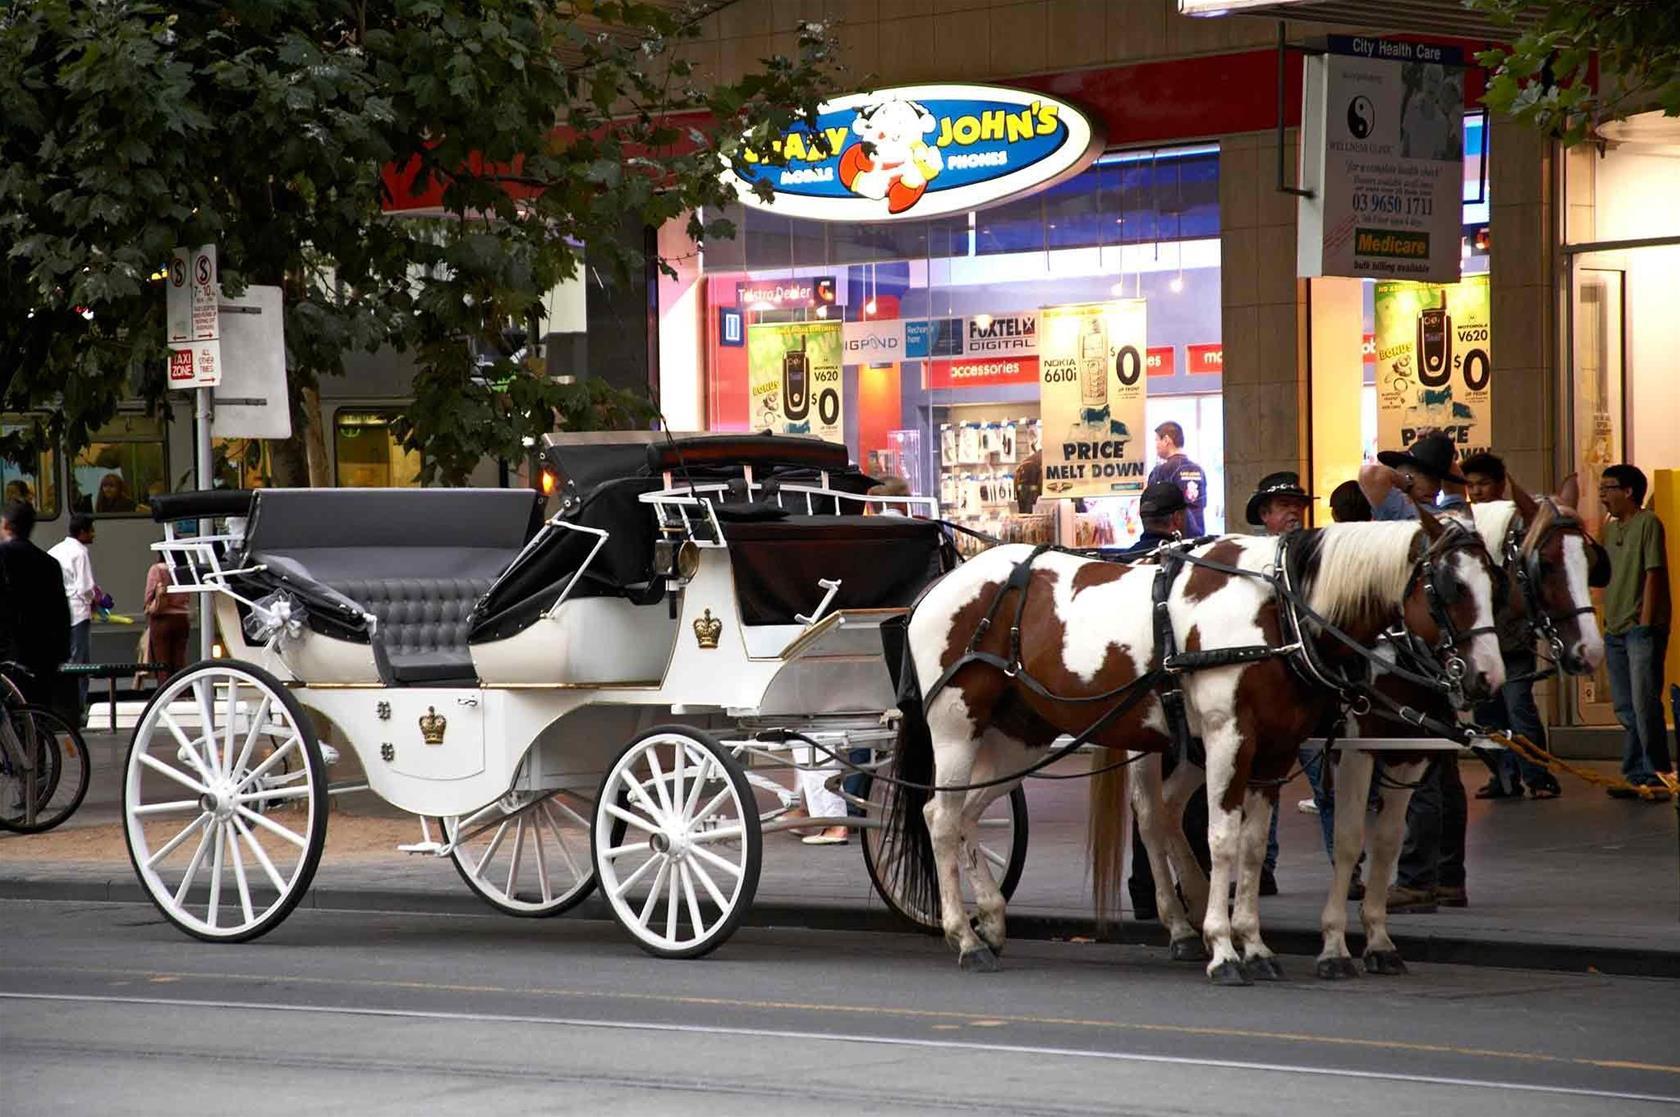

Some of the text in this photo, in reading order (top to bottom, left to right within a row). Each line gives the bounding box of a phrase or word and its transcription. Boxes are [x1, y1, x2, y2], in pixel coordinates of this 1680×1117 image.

[1353, 38, 1441, 60] City Health Care
[936, 101, 1059, 147] JOHN'S
[947, 151, 1008, 170] PHONES
[1352, 193, 1433, 216] 03 9650 1711
[1359, 233, 1426, 256] Medicare
[845, 334, 898, 350] IGPOND
[1458, 329, 1488, 342] V620
[970, 339, 1036, 351] DIGITAL
[171, 365, 193, 377] ZONE
[951, 361, 1019, 378] accessories
[1044, 358, 1076, 367] NOKIA
[814, 371, 839, 381] V620
[1044, 367, 1077, 383] 6610i
[1062, 441, 1124, 461] PRICE
[1046, 462, 1145, 480] MELT DOWN
